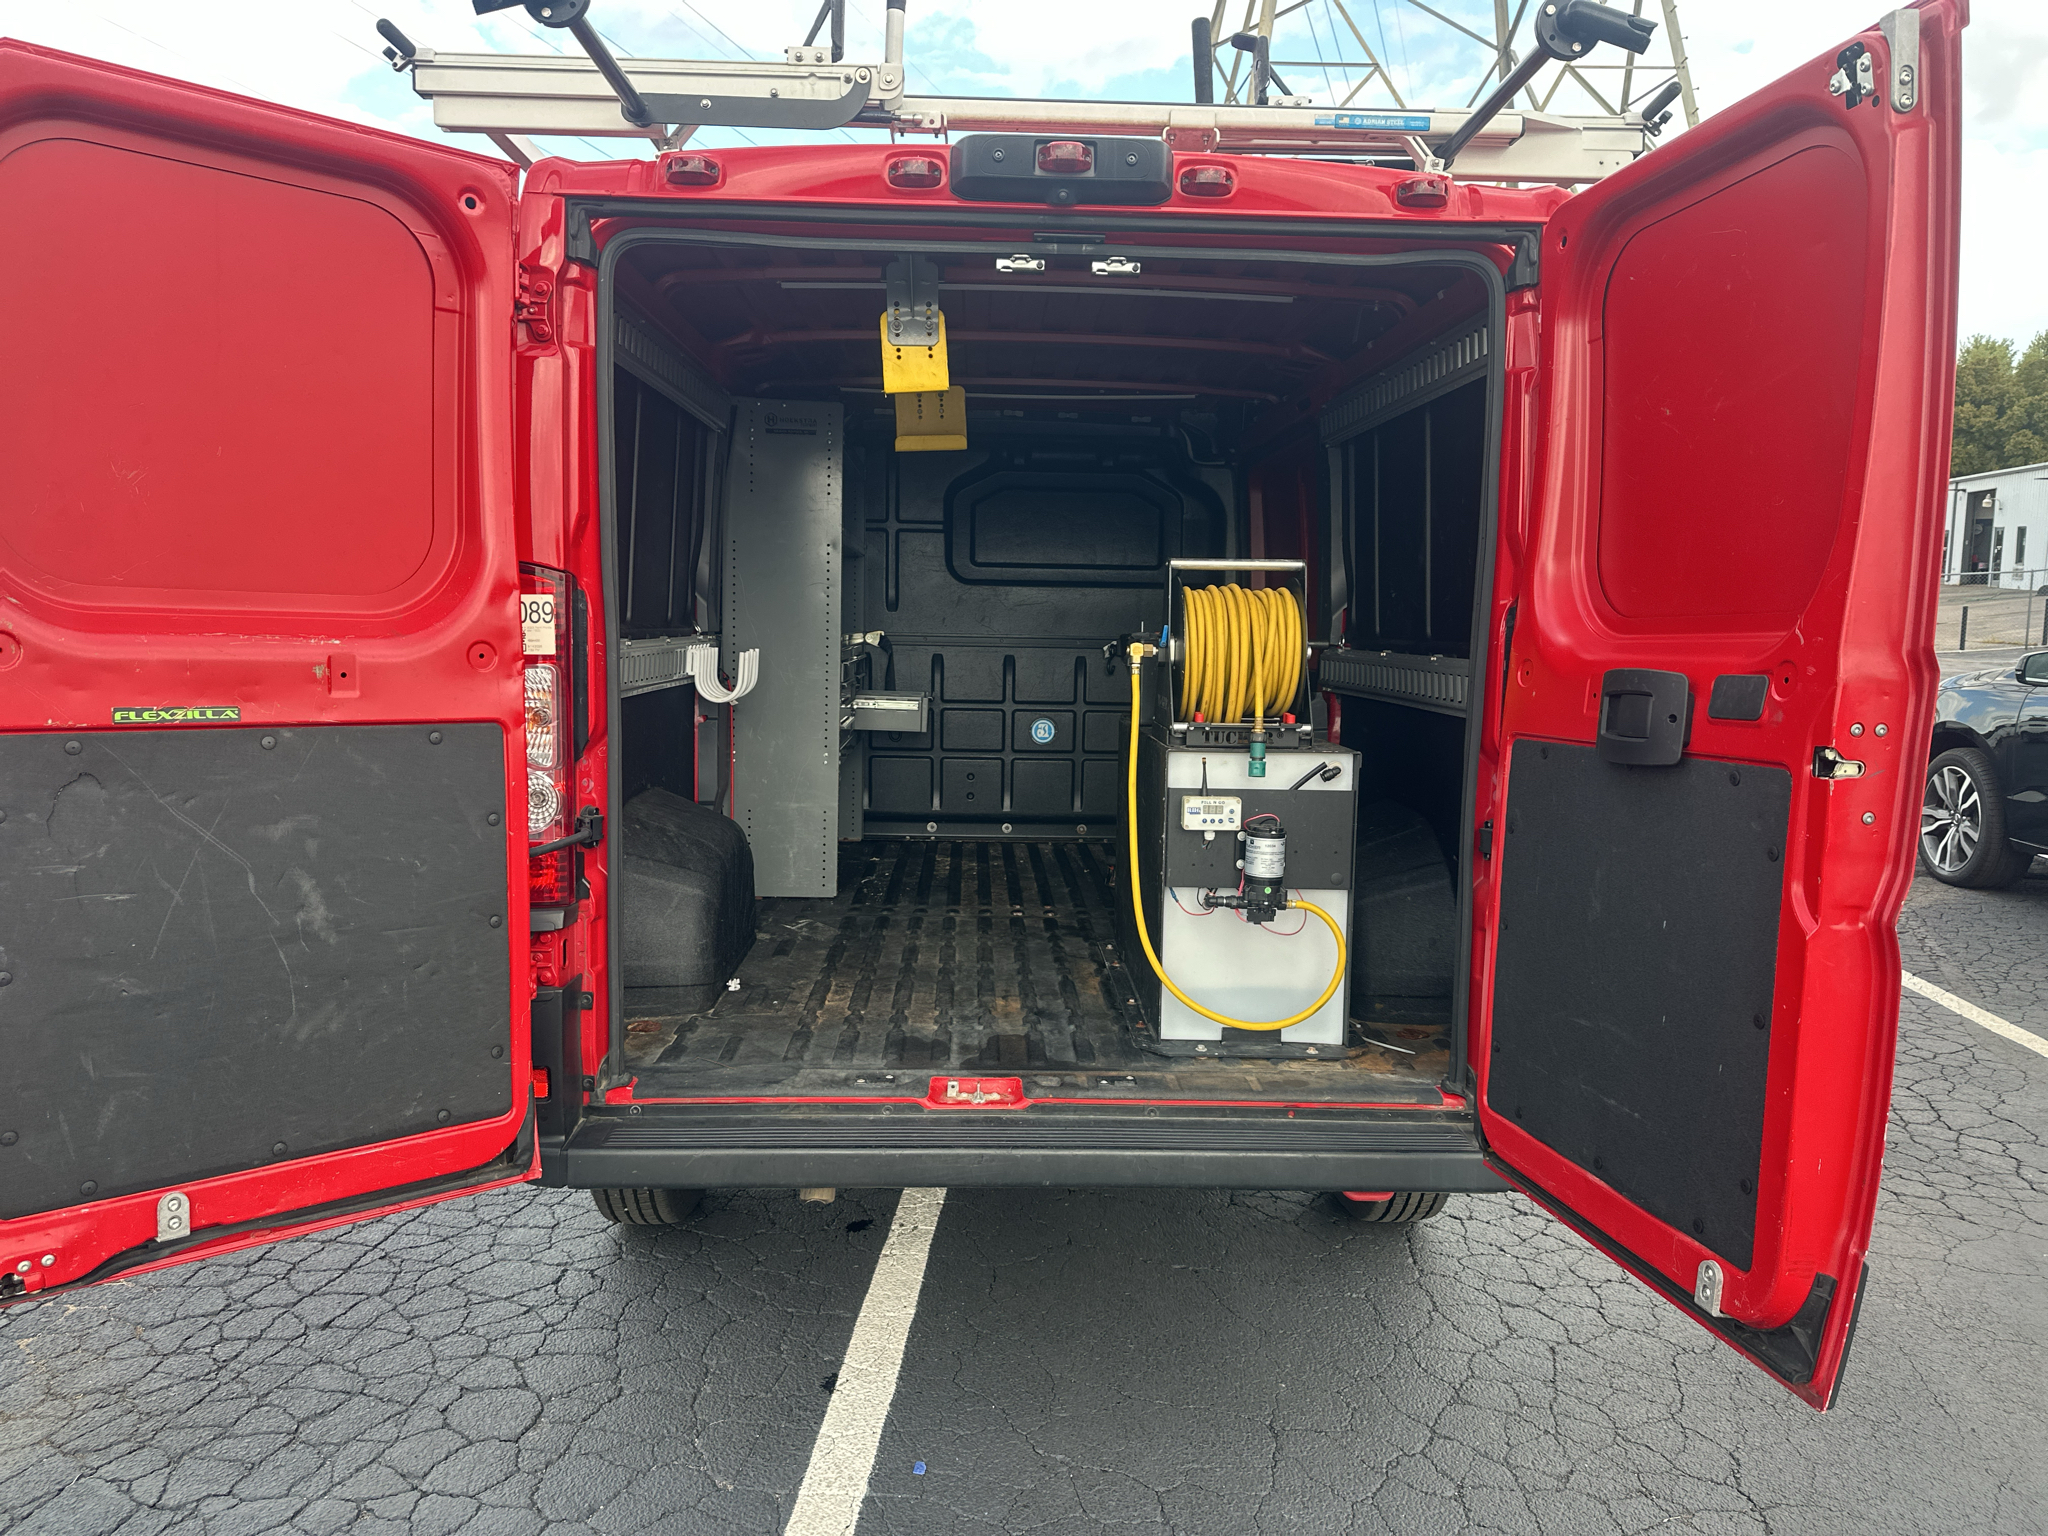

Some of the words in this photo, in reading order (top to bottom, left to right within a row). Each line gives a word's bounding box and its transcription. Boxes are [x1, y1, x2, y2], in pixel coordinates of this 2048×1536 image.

[1362, 117, 1385, 125] ADRIAN
[1386, 118, 1405, 126] STEEL
[114, 708, 238, 722] FLEXZILLA
[1201, 730, 1275, 745] TUCKR
